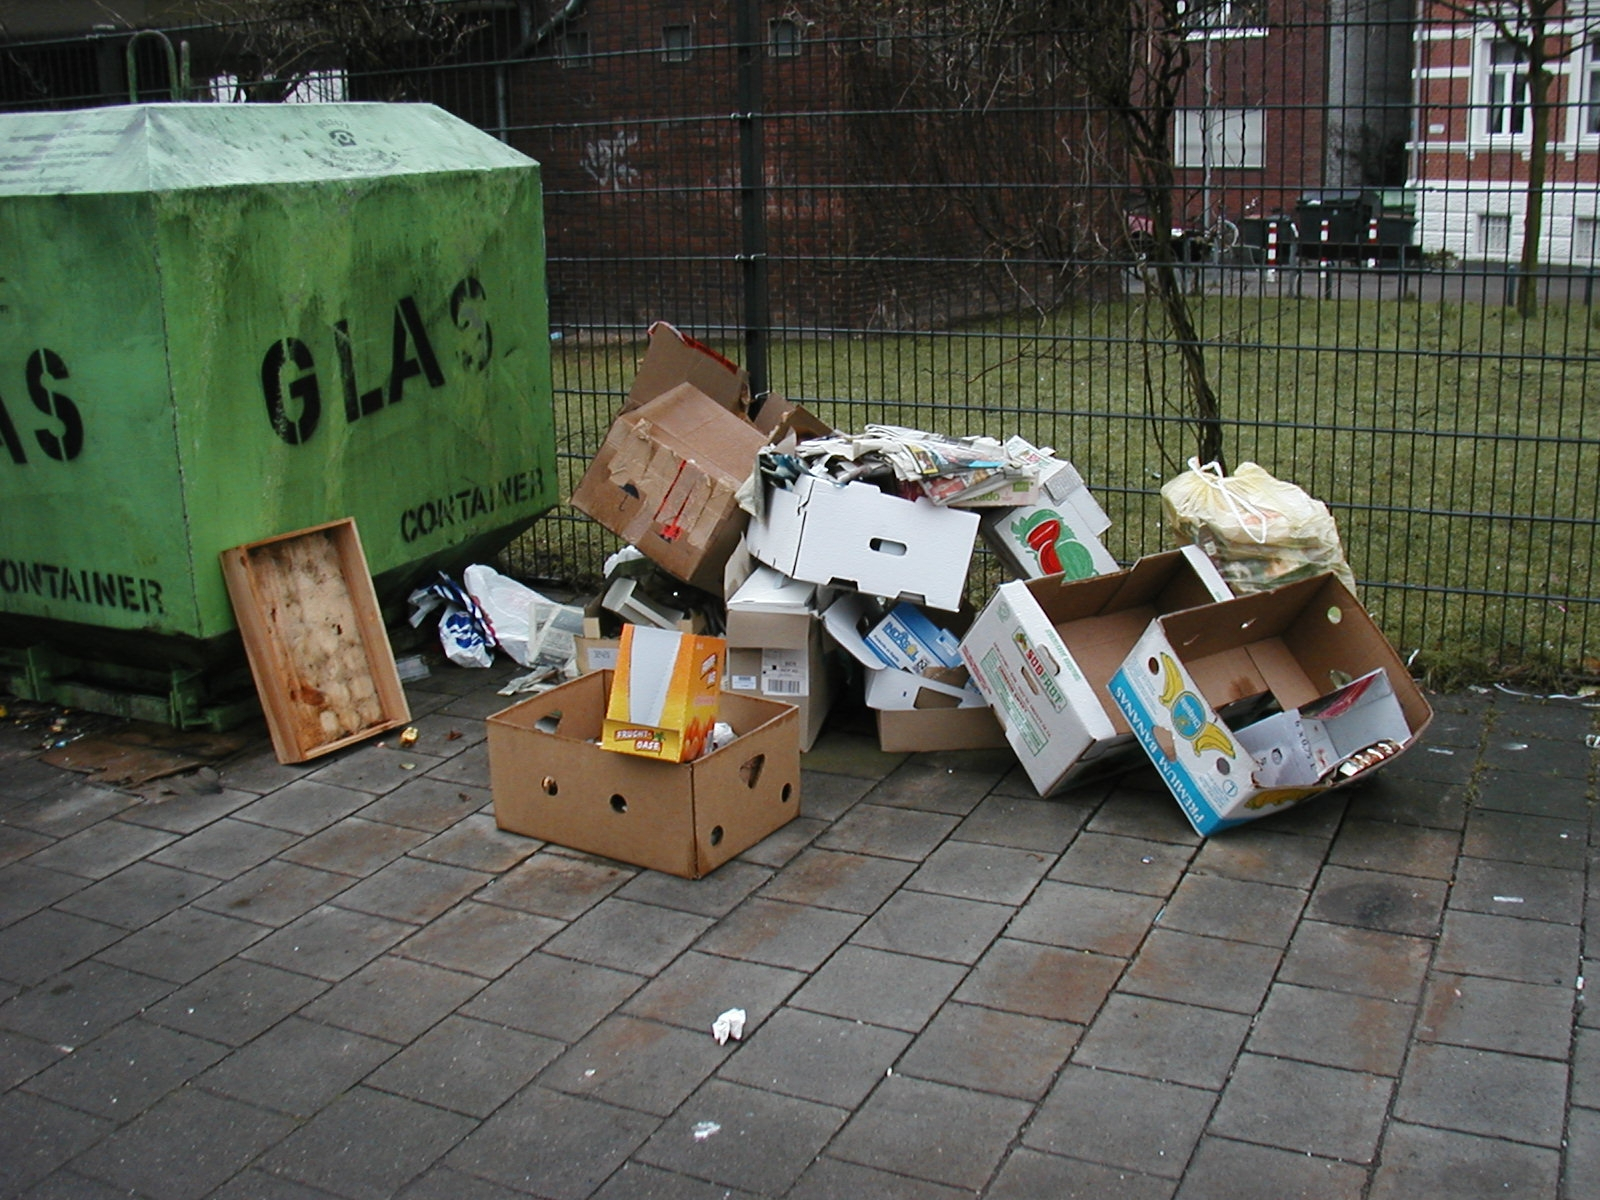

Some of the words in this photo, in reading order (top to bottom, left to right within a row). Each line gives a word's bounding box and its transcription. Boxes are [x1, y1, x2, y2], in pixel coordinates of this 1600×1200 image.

[261, 277, 493, 445] GLAS
[401, 467, 544, 543] CONTAINER
[636, 741, 660, 750] OASE
[1114, 686, 1159, 753] BANANAS
[1156, 754, 1205, 824] PREMIUM
